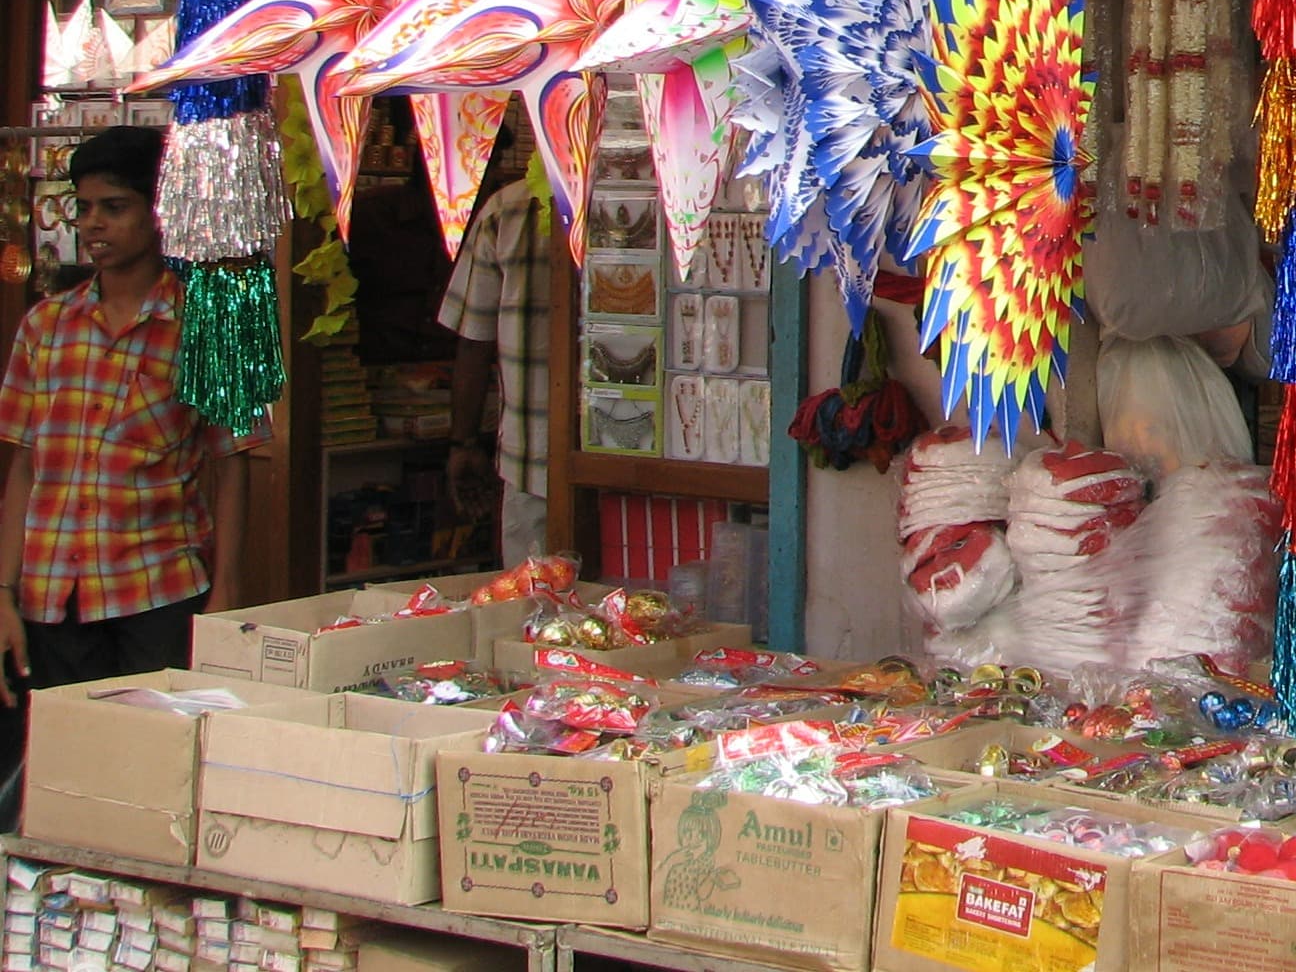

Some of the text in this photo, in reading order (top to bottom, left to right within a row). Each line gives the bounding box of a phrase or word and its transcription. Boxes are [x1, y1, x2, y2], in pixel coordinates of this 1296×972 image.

[737, 809, 814, 848] Amul
[470, 851, 601, 882] VANASPATI
[965, 892, 1026, 919] BAKEFAT
